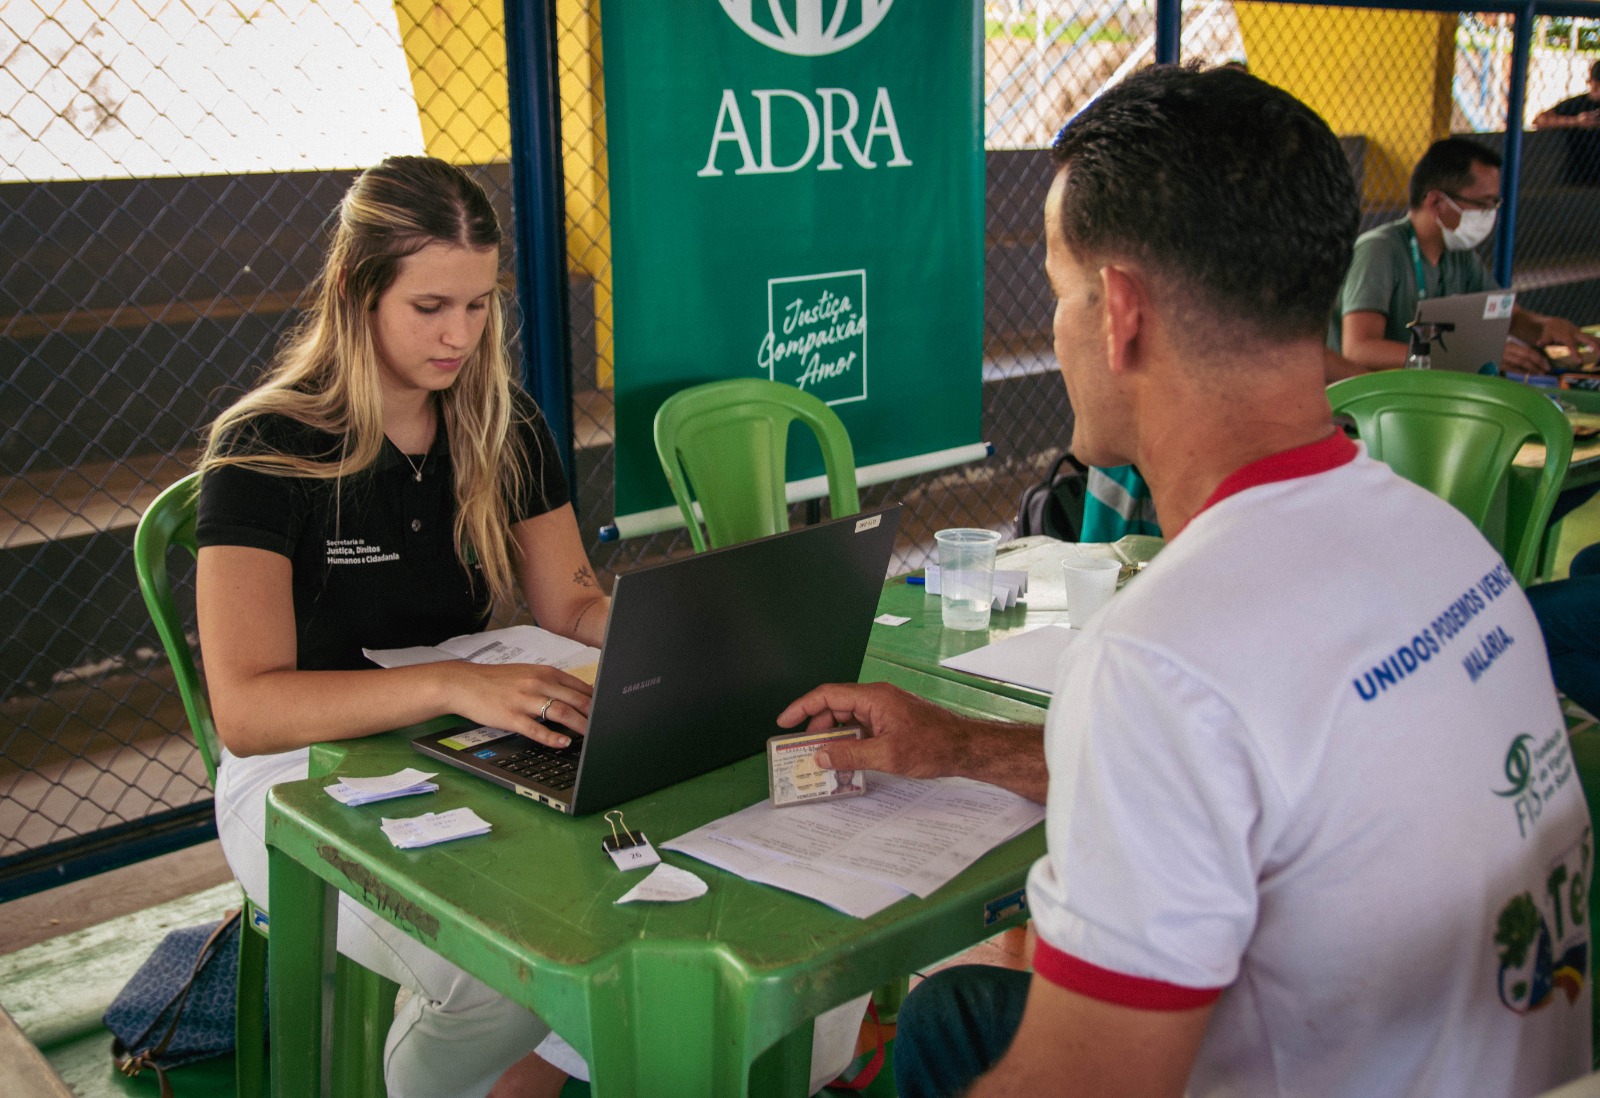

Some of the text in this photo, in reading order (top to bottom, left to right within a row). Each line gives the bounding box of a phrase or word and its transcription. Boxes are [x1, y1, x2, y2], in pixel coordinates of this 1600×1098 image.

[697, 87, 913, 177] ADRA
[783, 290, 852, 335] Justiça
[757, 313, 866, 368] Compaixão
[796, 351, 856, 391] Amor
[326, 538, 358, 546] Secretaria
[326, 546, 356, 556] Justiça,
[327, 556, 361, 564] Humanos
[366, 552, 400, 563] Cidadania
[1353, 563, 1511, 701] UNIDOS PODEMOS VENC
[622, 676, 661, 694] SAMSUNG
[796, 791, 829, 800] VENEZOLANO
[629, 852, 642, 860] 26
